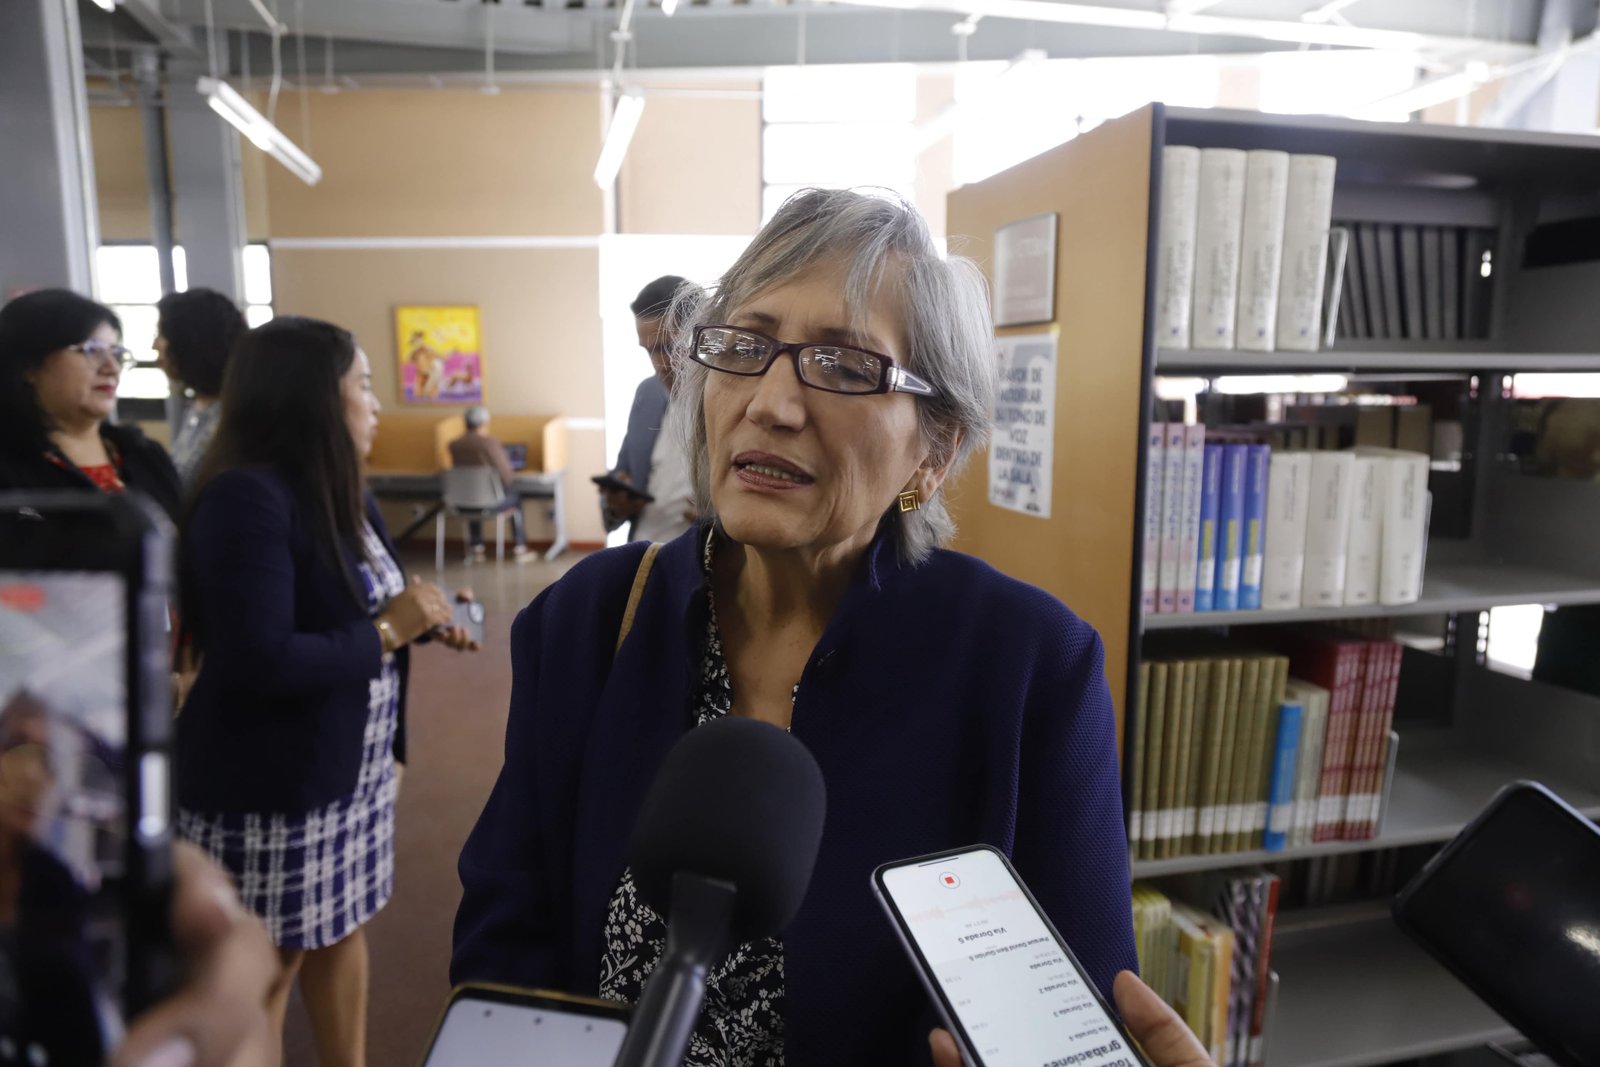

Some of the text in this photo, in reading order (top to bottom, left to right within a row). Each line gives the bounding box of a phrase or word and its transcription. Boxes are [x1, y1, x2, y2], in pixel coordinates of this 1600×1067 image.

[1031, 367, 1042, 383] DE
[1034, 409, 1046, 427] DE
[1010, 429, 1028, 445] VOZ
[964, 930, 994, 942] Dorada
[1029, 960, 1053, 970] Dorada
[1044, 982, 1068, 992] Dorada
[1059, 1005, 1083, 1015] Dorada
[1074, 1028, 1099, 1039] Dorada
